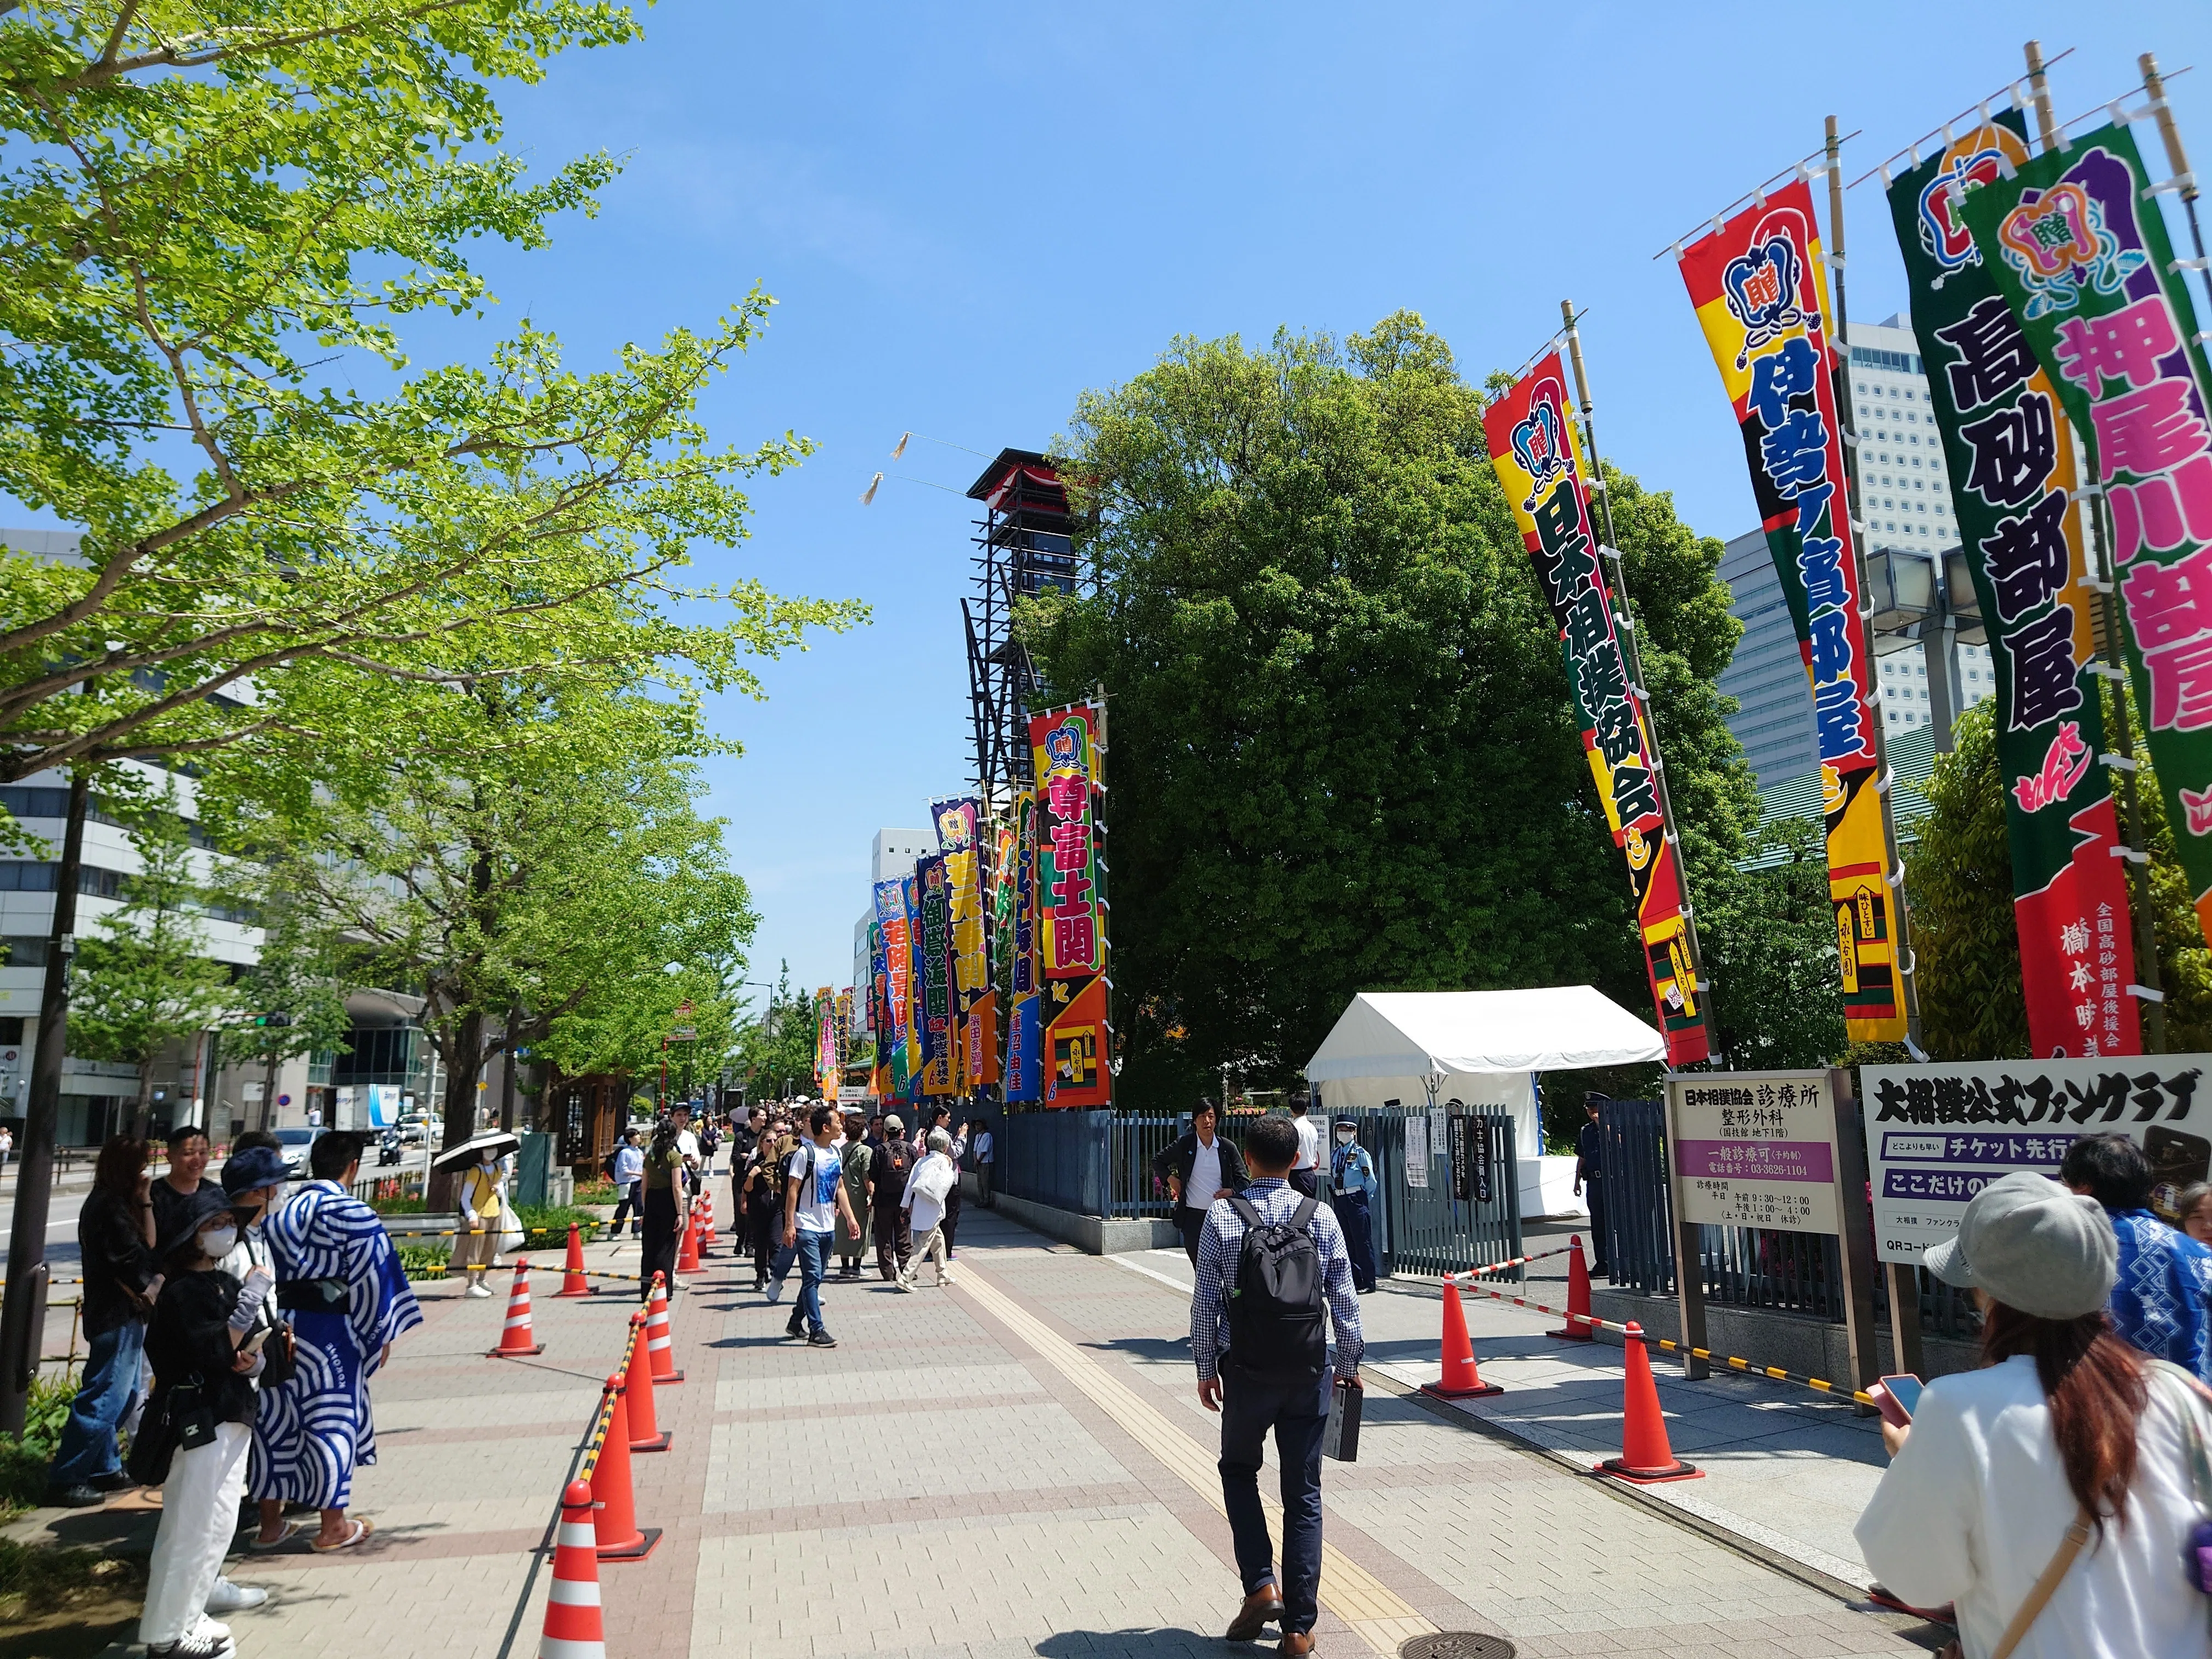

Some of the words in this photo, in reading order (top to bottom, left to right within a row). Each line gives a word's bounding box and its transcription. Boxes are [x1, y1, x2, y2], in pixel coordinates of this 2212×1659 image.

[1933, 295, 2083, 732] 高砂部屋
[2055, 294, 2212, 732] 押尾川部屋
[1533, 478, 1659, 831] 日本相撲協会
[1858, 891, 1874, 936] 味ひとすじ
[2096, 901, 2121, 1047] 全国高砂部屋後援会
[969, 1014, 983, 1076] 柴田多満美
[1684, 1084, 1820, 1109] 日本相撲協会診療所
[1874, 1067, 2204, 1126] 大相撲公式ファンクラブ
[1722, 1108, 1784, 1127] 整形外科
[1892, 1142, 1939, 1152] どこよりも早い
[1950, 1138, 2073, 1160] チケット先行
[1696, 1181, 1729, 1191] 診療時間
[1891, 1174, 1997, 1196] ここだけの
[1712, 1192, 1725, 1200] 平日
[1734, 1193, 1749, 1203] 午前
[1735, 1203, 1751, 1213] 午後
[1895, 1216, 1918, 1227] 大相撲
[1887, 1239, 1937, 1252] QRコード
